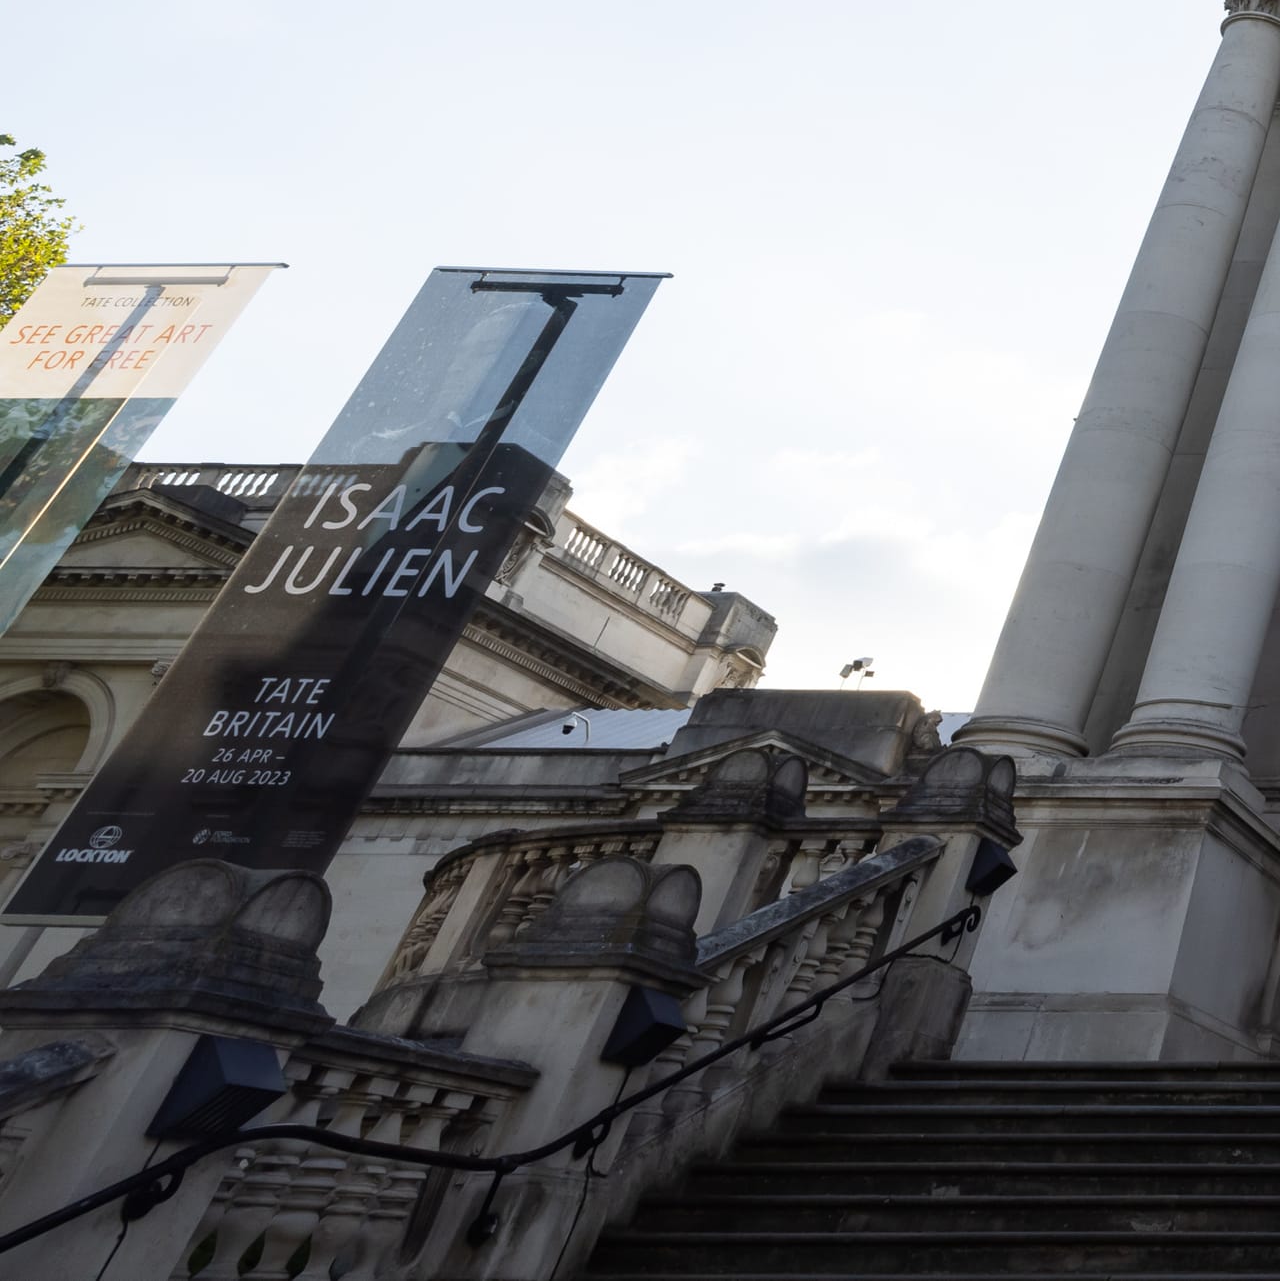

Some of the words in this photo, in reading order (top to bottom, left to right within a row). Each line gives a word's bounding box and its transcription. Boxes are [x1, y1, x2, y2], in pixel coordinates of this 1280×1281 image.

[80, 297, 111, 307] TATE
[114, 296, 194, 307] COLLECTION
[9, 325, 62, 344] SEE
[64, 325, 154, 344] GREAT
[153, 324, 213, 344] ART
[27, 350, 85, 369] FOR
[88, 350, 156, 369] FREE
[304, 482, 506, 533] ISAAC
[244, 545, 479, 598] JULIEN
[254, 677, 330, 704] TATE
[203, 711, 336, 739] BRITAIN
[212, 748, 236, 762] 26
[237, 749, 273, 763] APR
[181, 769, 206, 783] 20
[207, 769, 246, 784] AUG
[247, 770, 291, 786] 2023
[56, 848, 132, 863] LOCKTON
